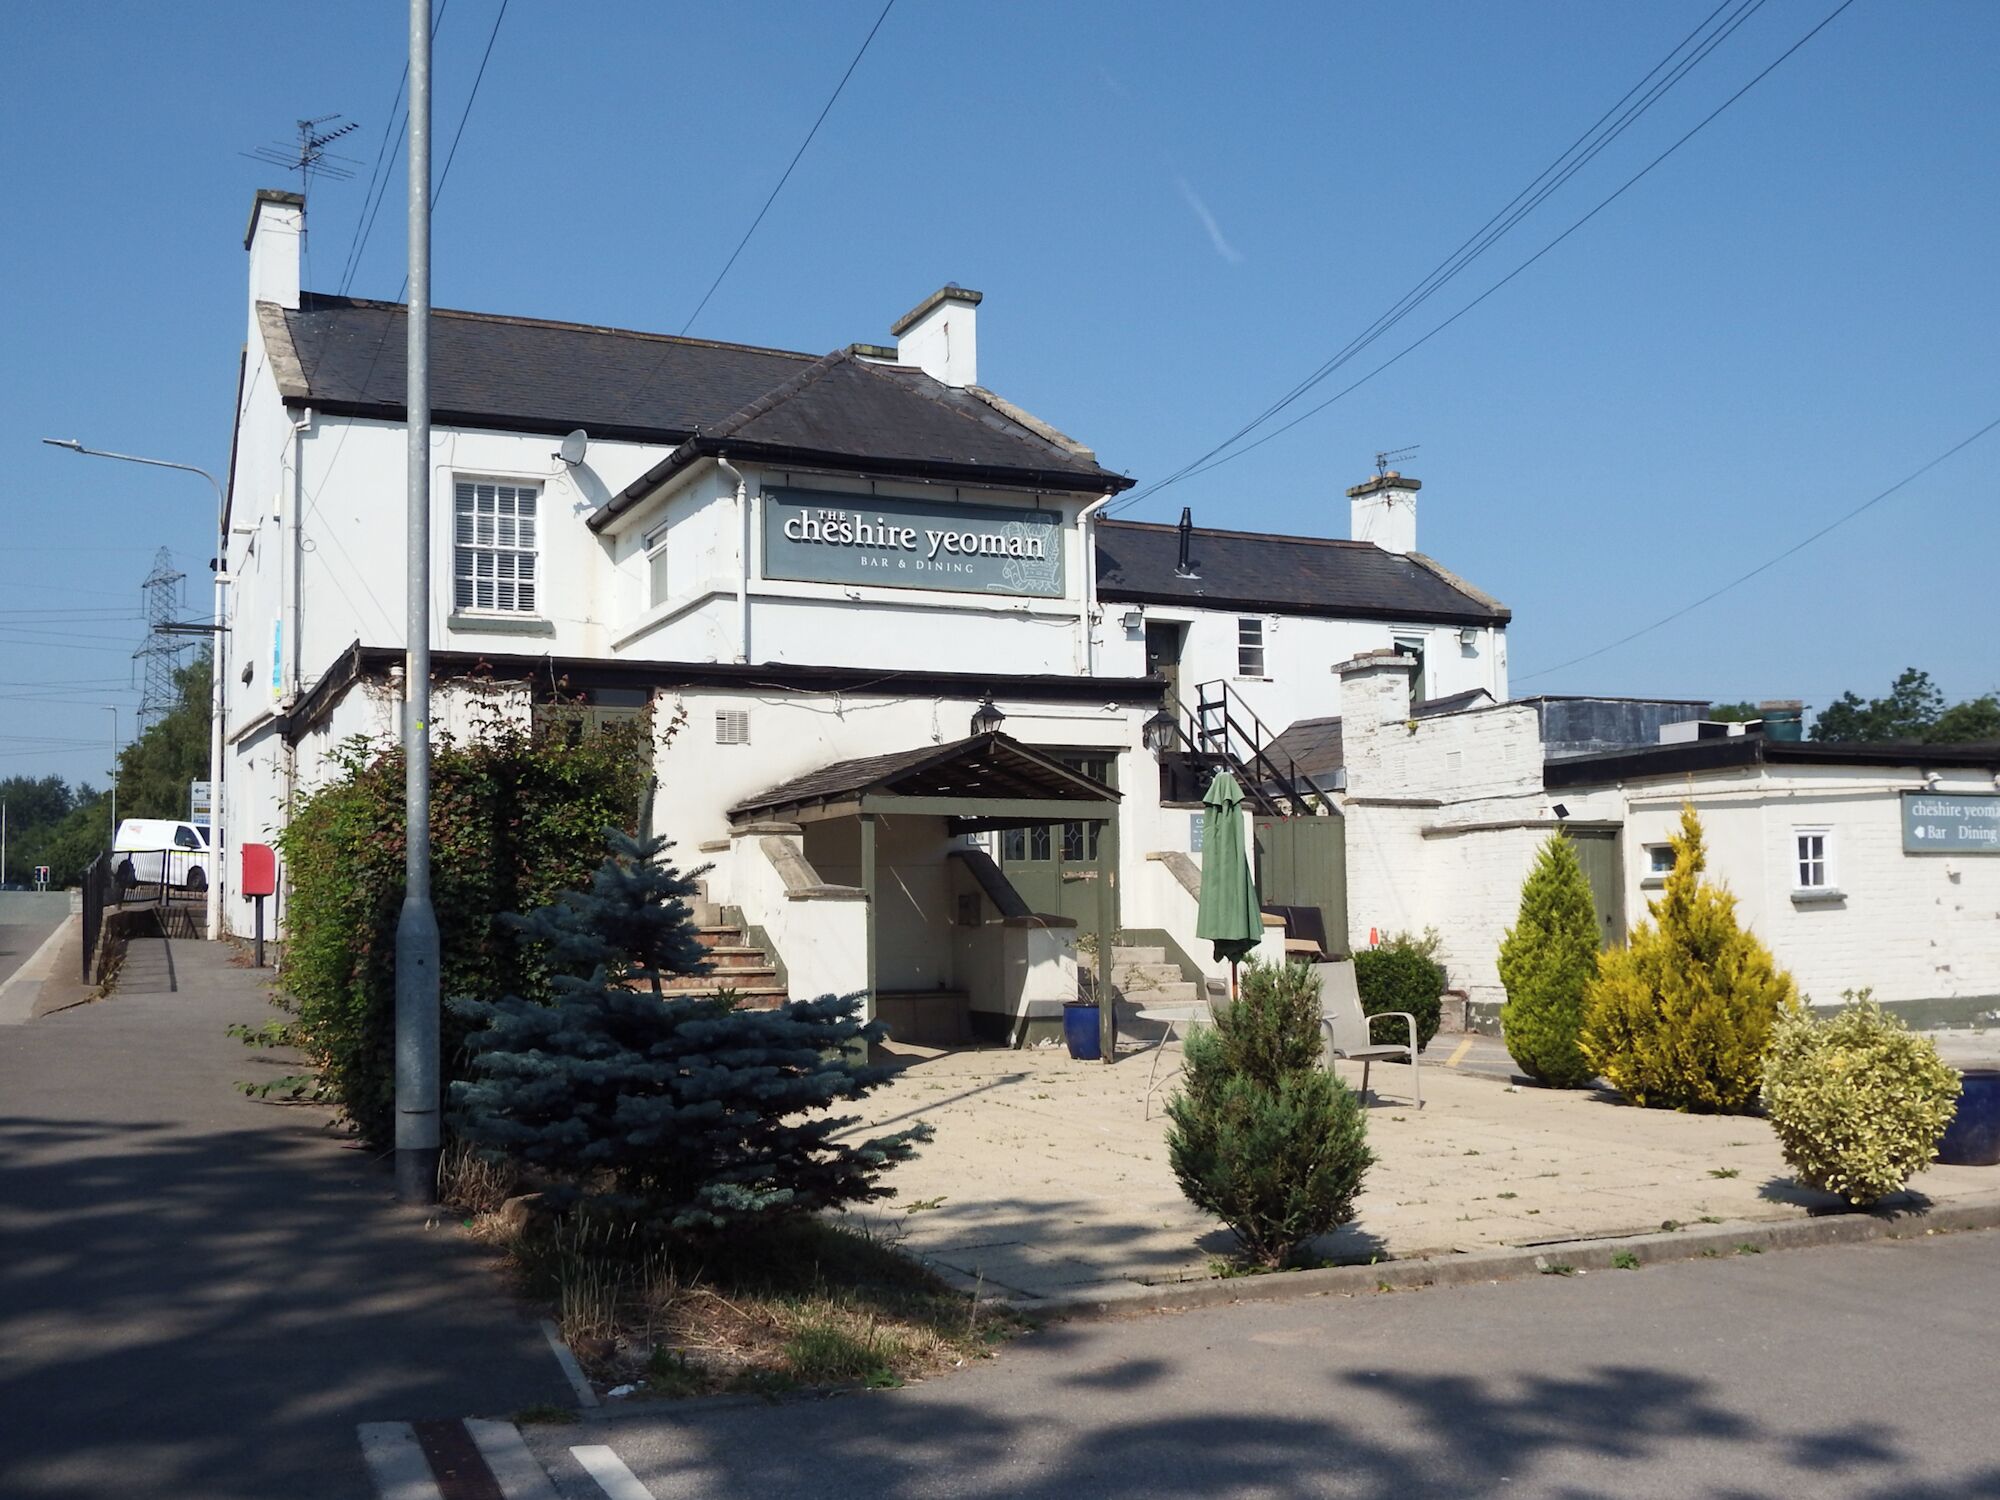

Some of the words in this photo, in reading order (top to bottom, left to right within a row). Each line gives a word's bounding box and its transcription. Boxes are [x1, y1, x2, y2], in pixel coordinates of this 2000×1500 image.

[818, 509, 847, 521] THE
[783, 509, 917, 549] cheshire
[925, 529, 1045, 559] yeoman
[860, 556, 889, 568] BAR
[897, 558, 906, 569] &
[916, 559, 974, 574] DINING
[1911, 800, 1962, 817] cheshire
[1927, 825, 1947, 840] Bar
[1958, 824, 1998, 844] Dining
